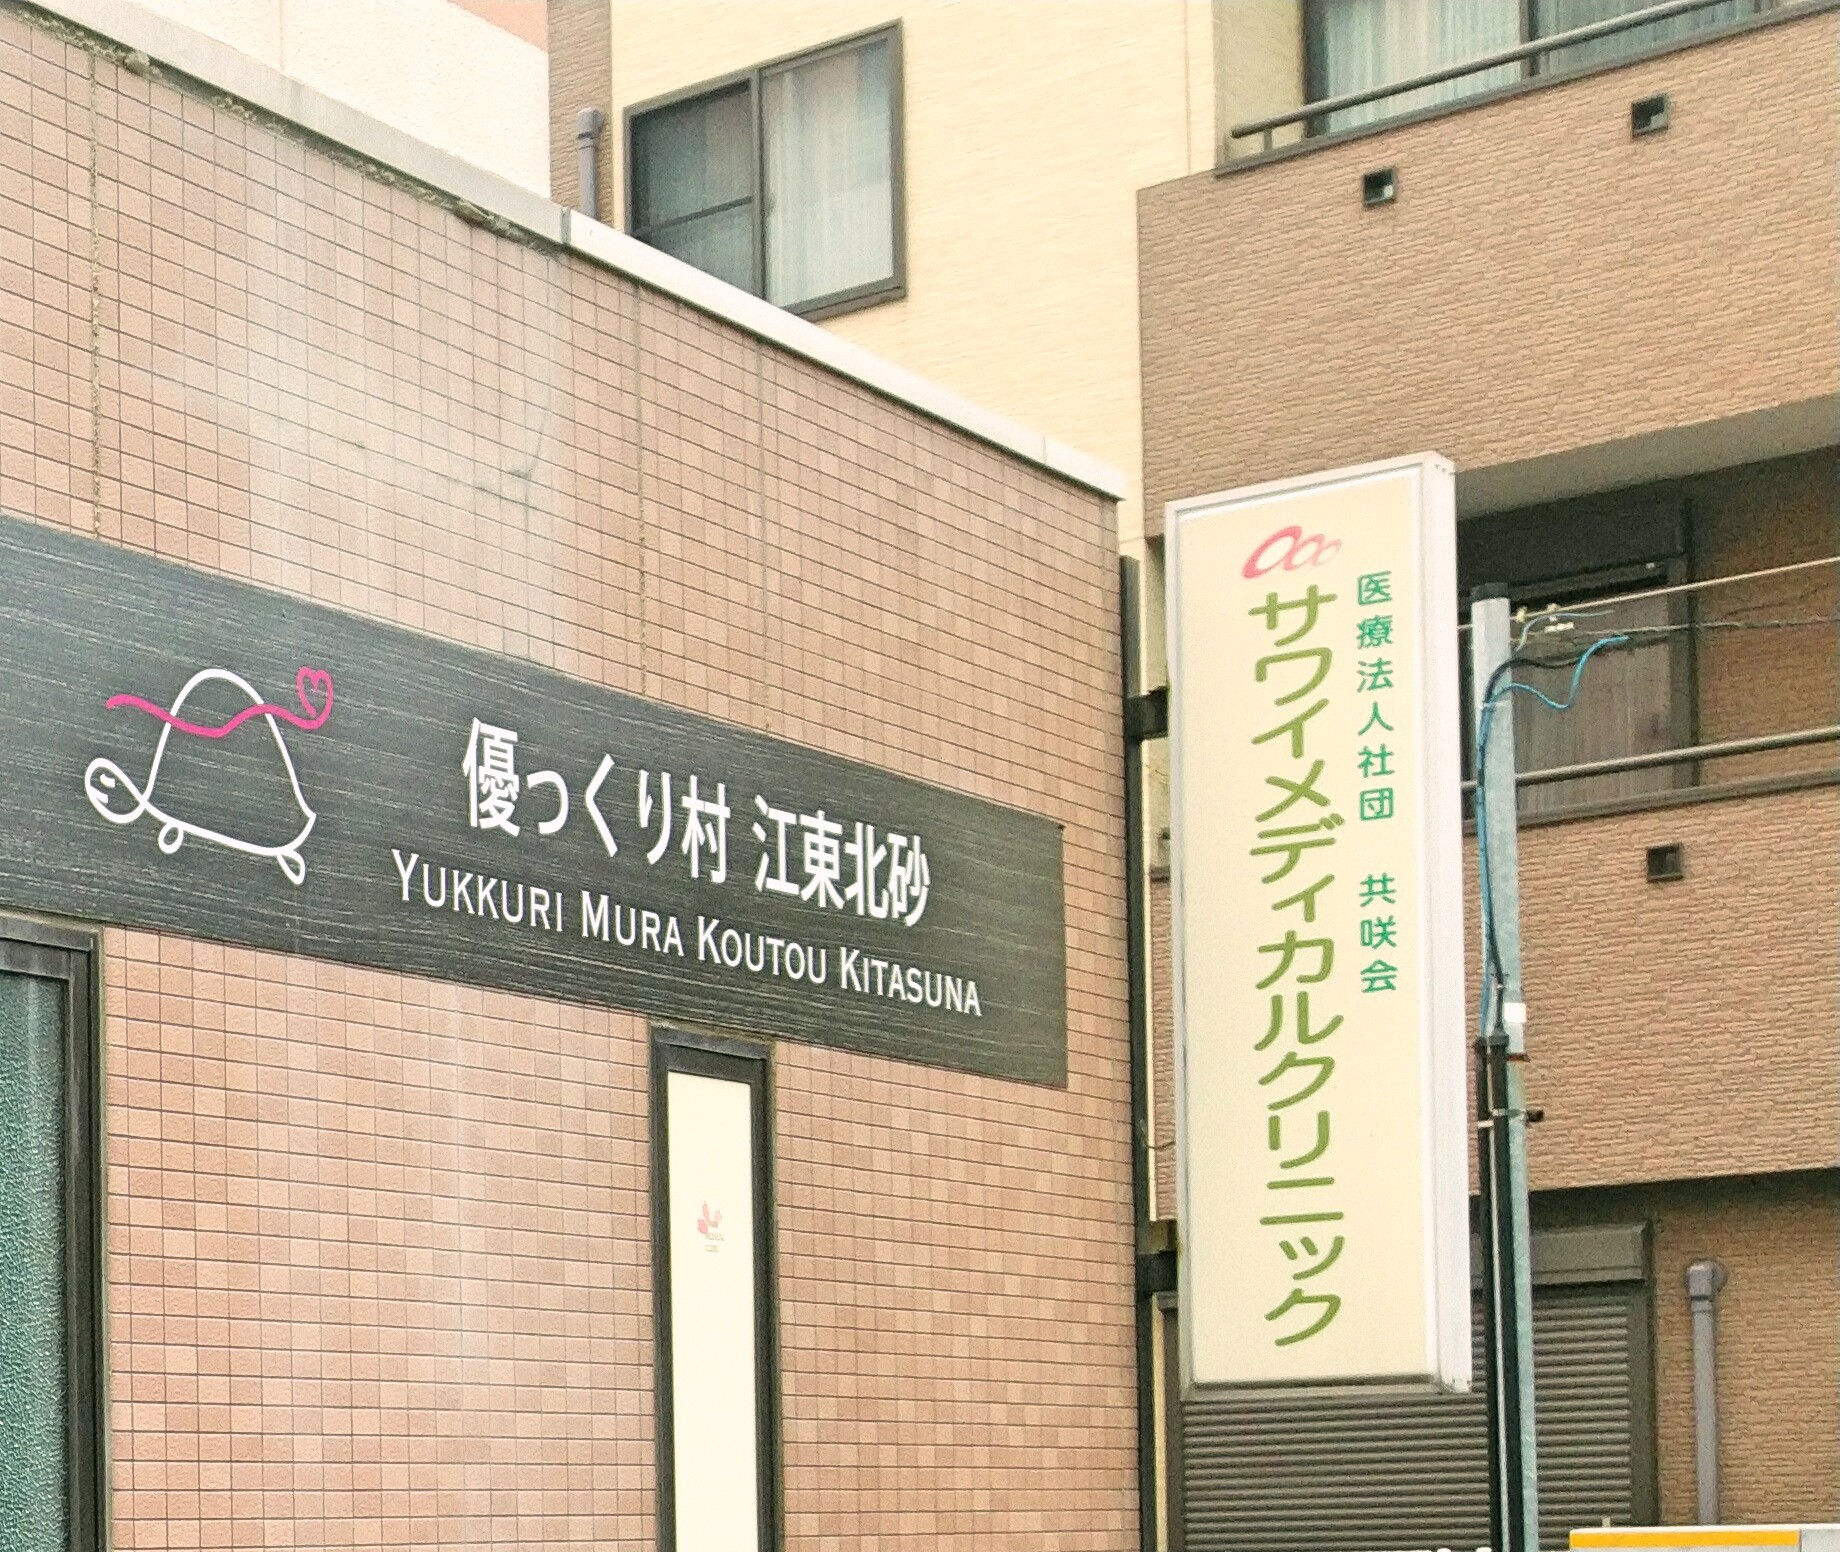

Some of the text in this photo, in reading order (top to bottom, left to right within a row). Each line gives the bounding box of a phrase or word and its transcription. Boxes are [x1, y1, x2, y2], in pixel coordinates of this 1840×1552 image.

[391, 848, 983, 1017] YUKKURI MURA KOUTOU KITASUNA
[462, 716, 931, 928] 優っくり村 江東北砂
[1356, 570, 1399, 994] 医療法人社団 共咲会
[1248, 584, 1345, 1348] サワイメディカルクリニック
